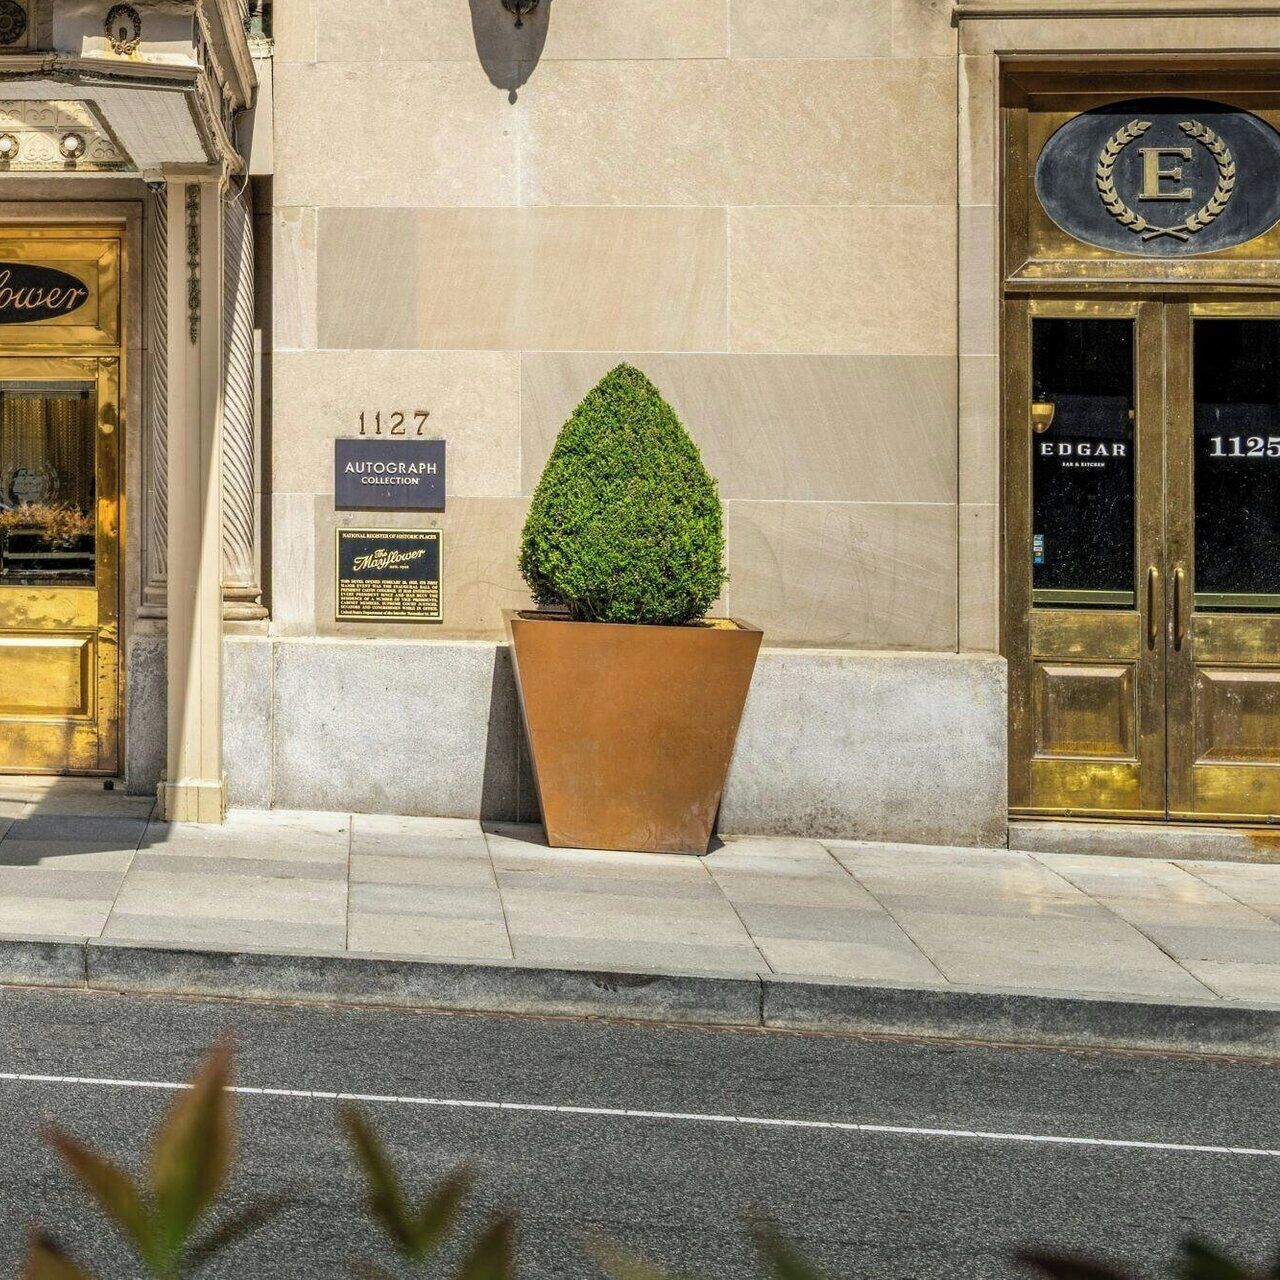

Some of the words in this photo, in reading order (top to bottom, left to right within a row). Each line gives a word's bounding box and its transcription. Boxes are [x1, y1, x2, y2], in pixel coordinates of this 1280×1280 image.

[1137, 146, 1194, 201] E
[359, 410, 430, 436] 1127
[1039, 441, 1127, 458] EDGAR
[1209, 436, 1280, 458] 1125
[344, 461, 437, 475] AUTOGRAPH
[361, 476, 420, 485] COLLECTION
[353, 549, 426, 571] Mayflower
